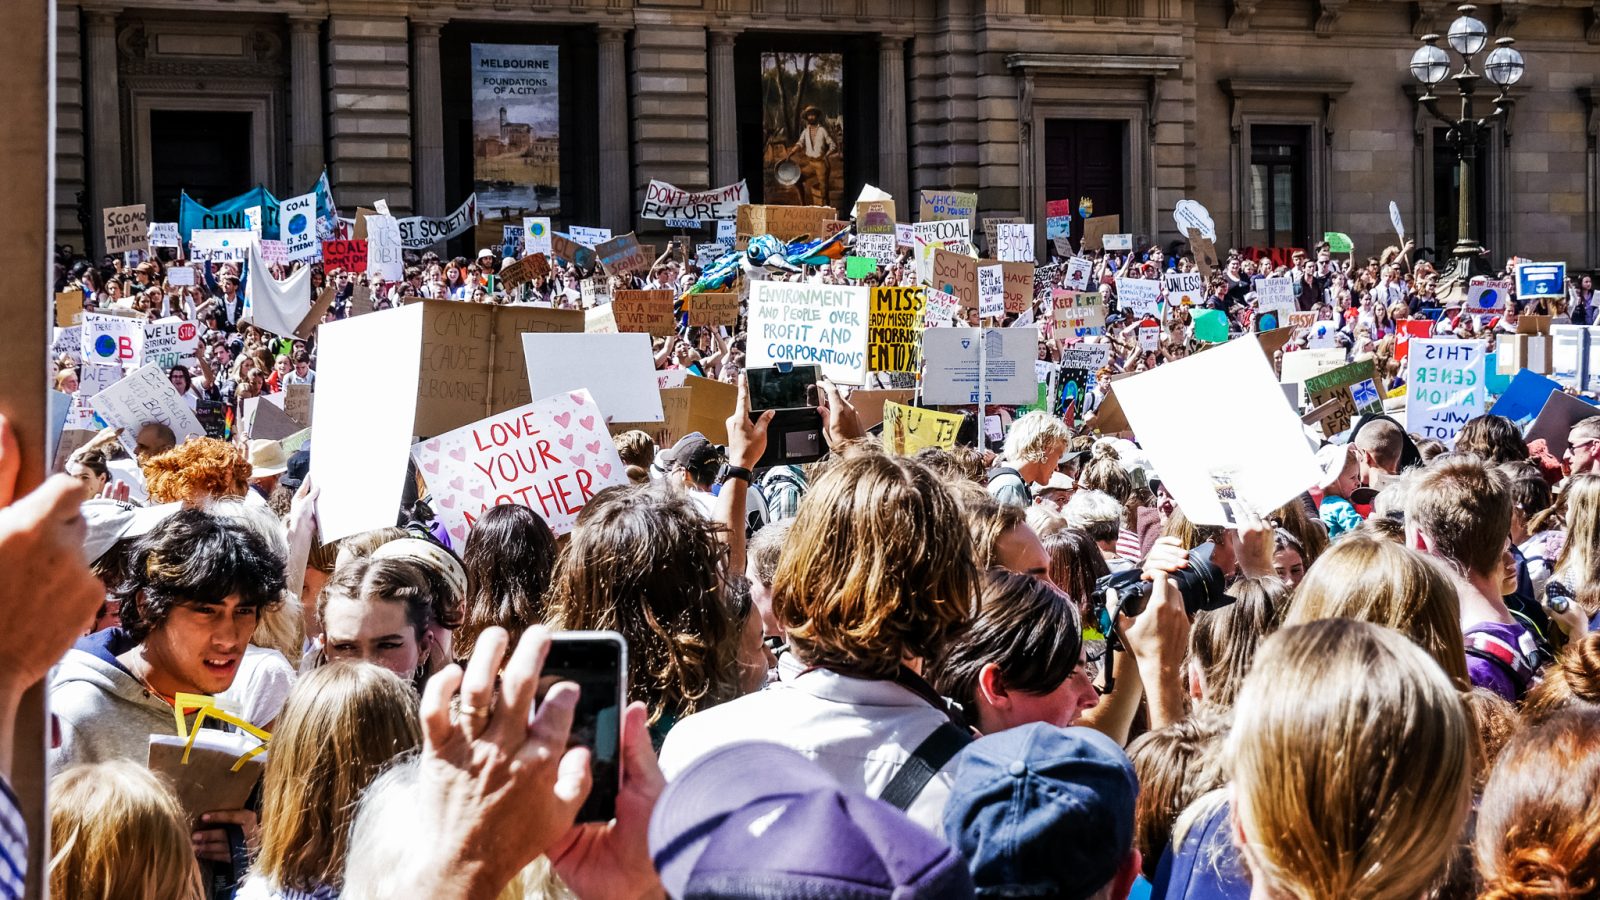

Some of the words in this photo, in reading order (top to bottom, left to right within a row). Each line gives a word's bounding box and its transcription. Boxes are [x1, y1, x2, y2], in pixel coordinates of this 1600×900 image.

[481, 59, 549, 69] MELBOURNE
[483, 78, 548, 86] FOUNDATIONS
[494, 86, 506, 94] OF
[517, 87, 537, 95] CITY
[723, 185, 744, 201] MY
[286, 198, 310, 211] COAL
[132, 223, 139, 231] A
[420, 207, 466, 237] SOCIETY
[287, 237, 293, 245] IS
[298, 233, 308, 242] SO
[936, 222, 969, 240] COAL
[1003, 272, 1031, 285] HAVE
[1166, 275, 1200, 292] UNLESS
[759, 285, 856, 308] ENVIRONMENT
[877, 288, 923, 311] MISS
[1053, 297, 1073, 309] KEEP
[636, 303, 644, 312] A
[758, 305, 779, 319] AND
[783, 305, 821, 321] PEOPLE
[829, 311, 860, 326] OVER
[434, 311, 489, 339] CAME
[627, 313, 644, 323] WE
[888, 312, 914, 327] MISSED
[144, 325, 176, 339] WE'LL
[179, 325, 196, 339] STOP
[763, 323, 813, 342] PROFIT
[819, 328, 852, 347] AND
[119, 336, 134, 359] B
[144, 337, 177, 349] STRIKING
[767, 343, 863, 369] CORPORATIONS
[142, 397, 171, 427] BOLD
[473, 411, 541, 451] LOVE
[474, 440, 562, 490] YOUR
